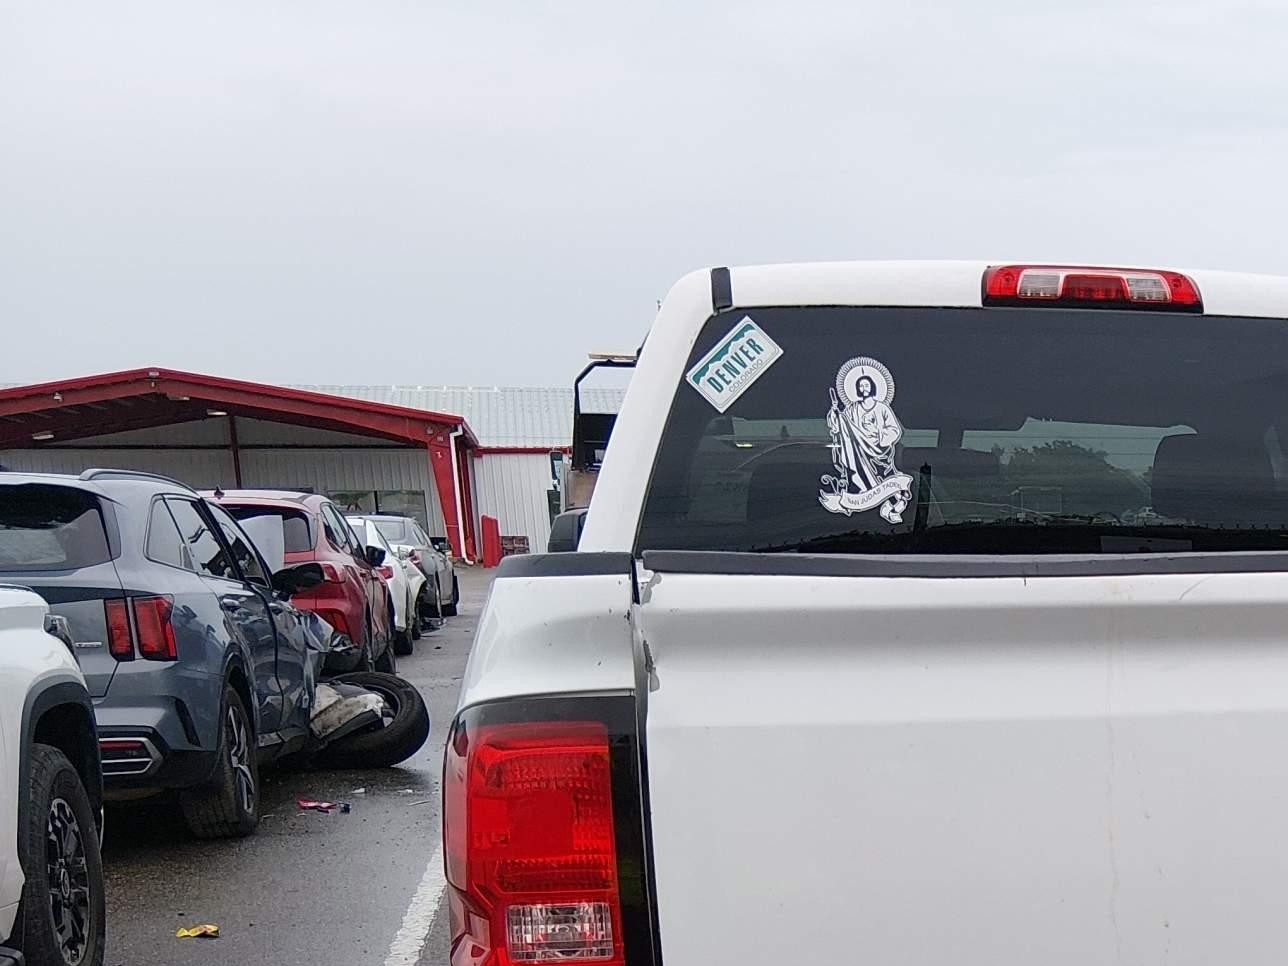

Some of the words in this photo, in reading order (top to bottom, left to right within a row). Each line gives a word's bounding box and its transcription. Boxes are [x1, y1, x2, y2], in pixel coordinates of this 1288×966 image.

[706, 338, 764, 393] DENVER
[729, 359, 763, 392] COLORADO
[860, 488, 881, 504] JUDAS
